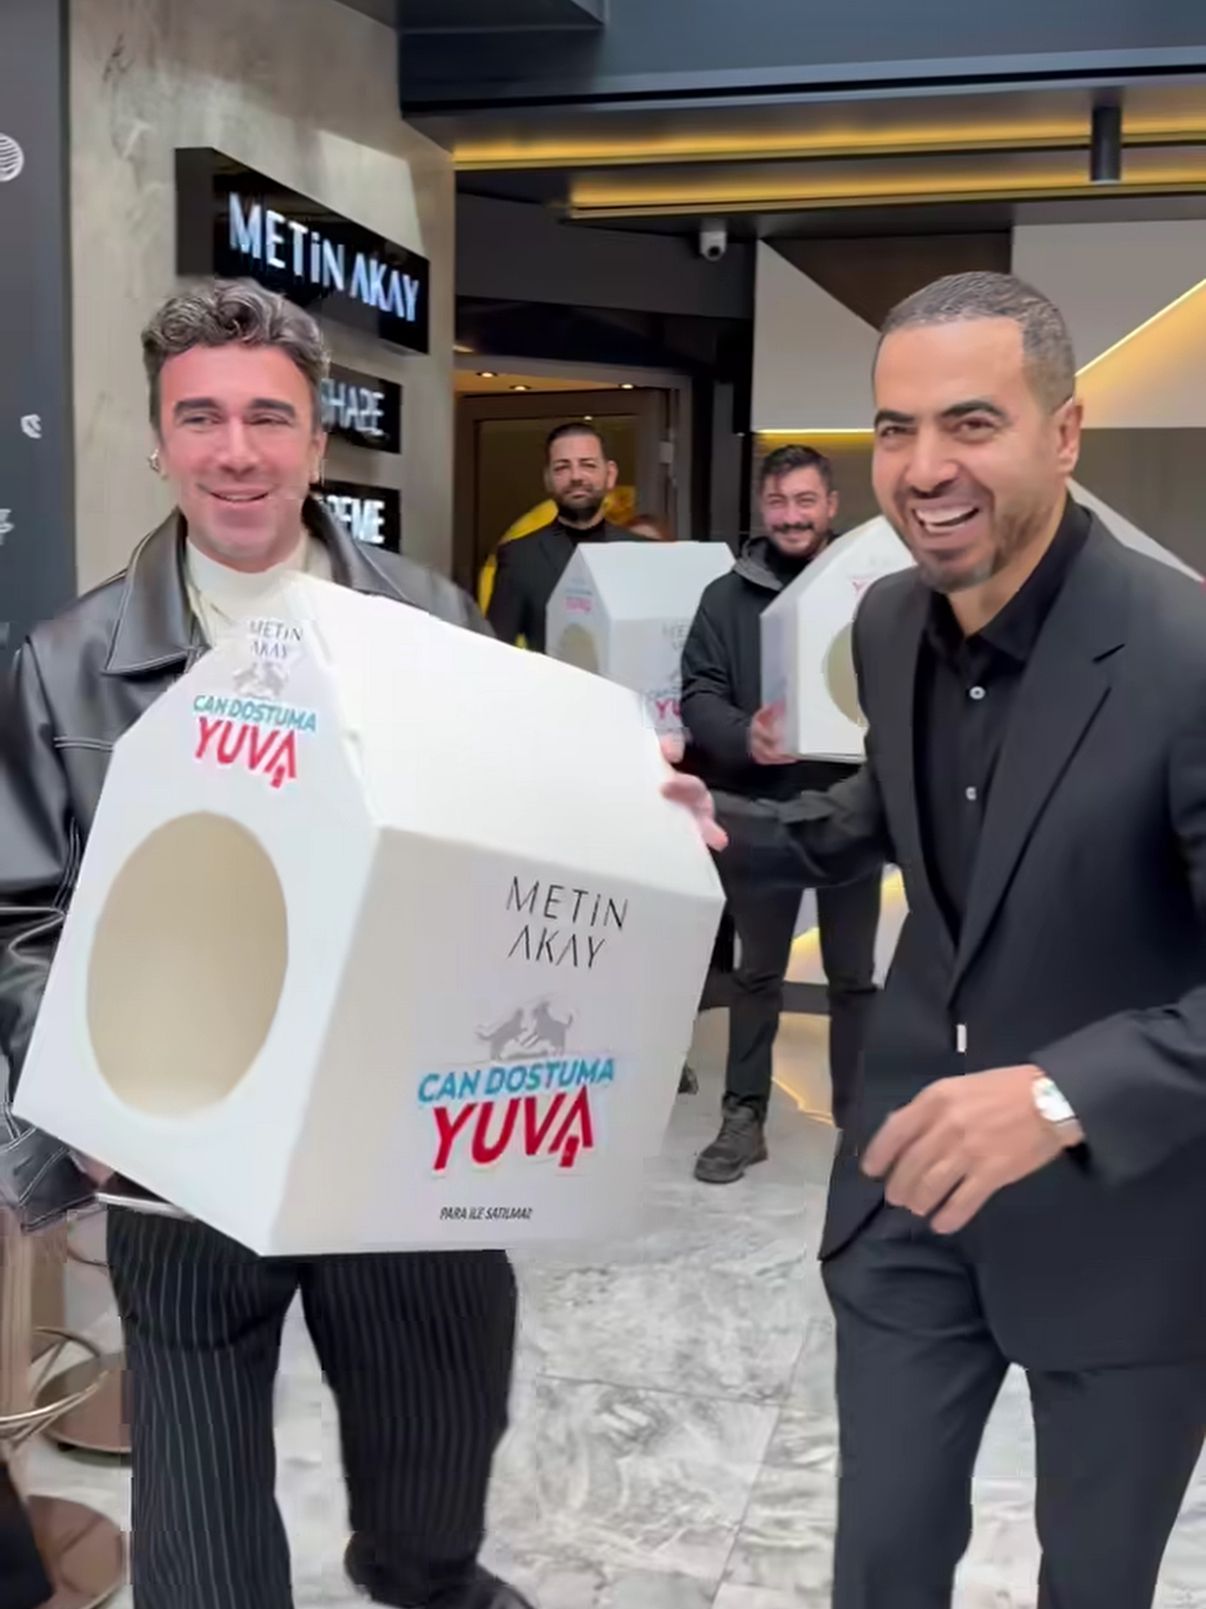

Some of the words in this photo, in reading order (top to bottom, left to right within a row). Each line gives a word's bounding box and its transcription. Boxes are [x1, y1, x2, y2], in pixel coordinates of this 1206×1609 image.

[351, 252, 419, 322] AKAY
[193, 695, 226, 715] CAN
[228, 700, 317, 732] DOSTUMA
[195, 716, 297, 788] YUVA
[506, 924, 606, 968] AKAY
[417, 1069, 482, 1103] CAN
[484, 1058, 615, 1095] DOSTUMA
[433, 1084, 594, 1171] YUVA
[439, 1206, 467, 1220] PARA
